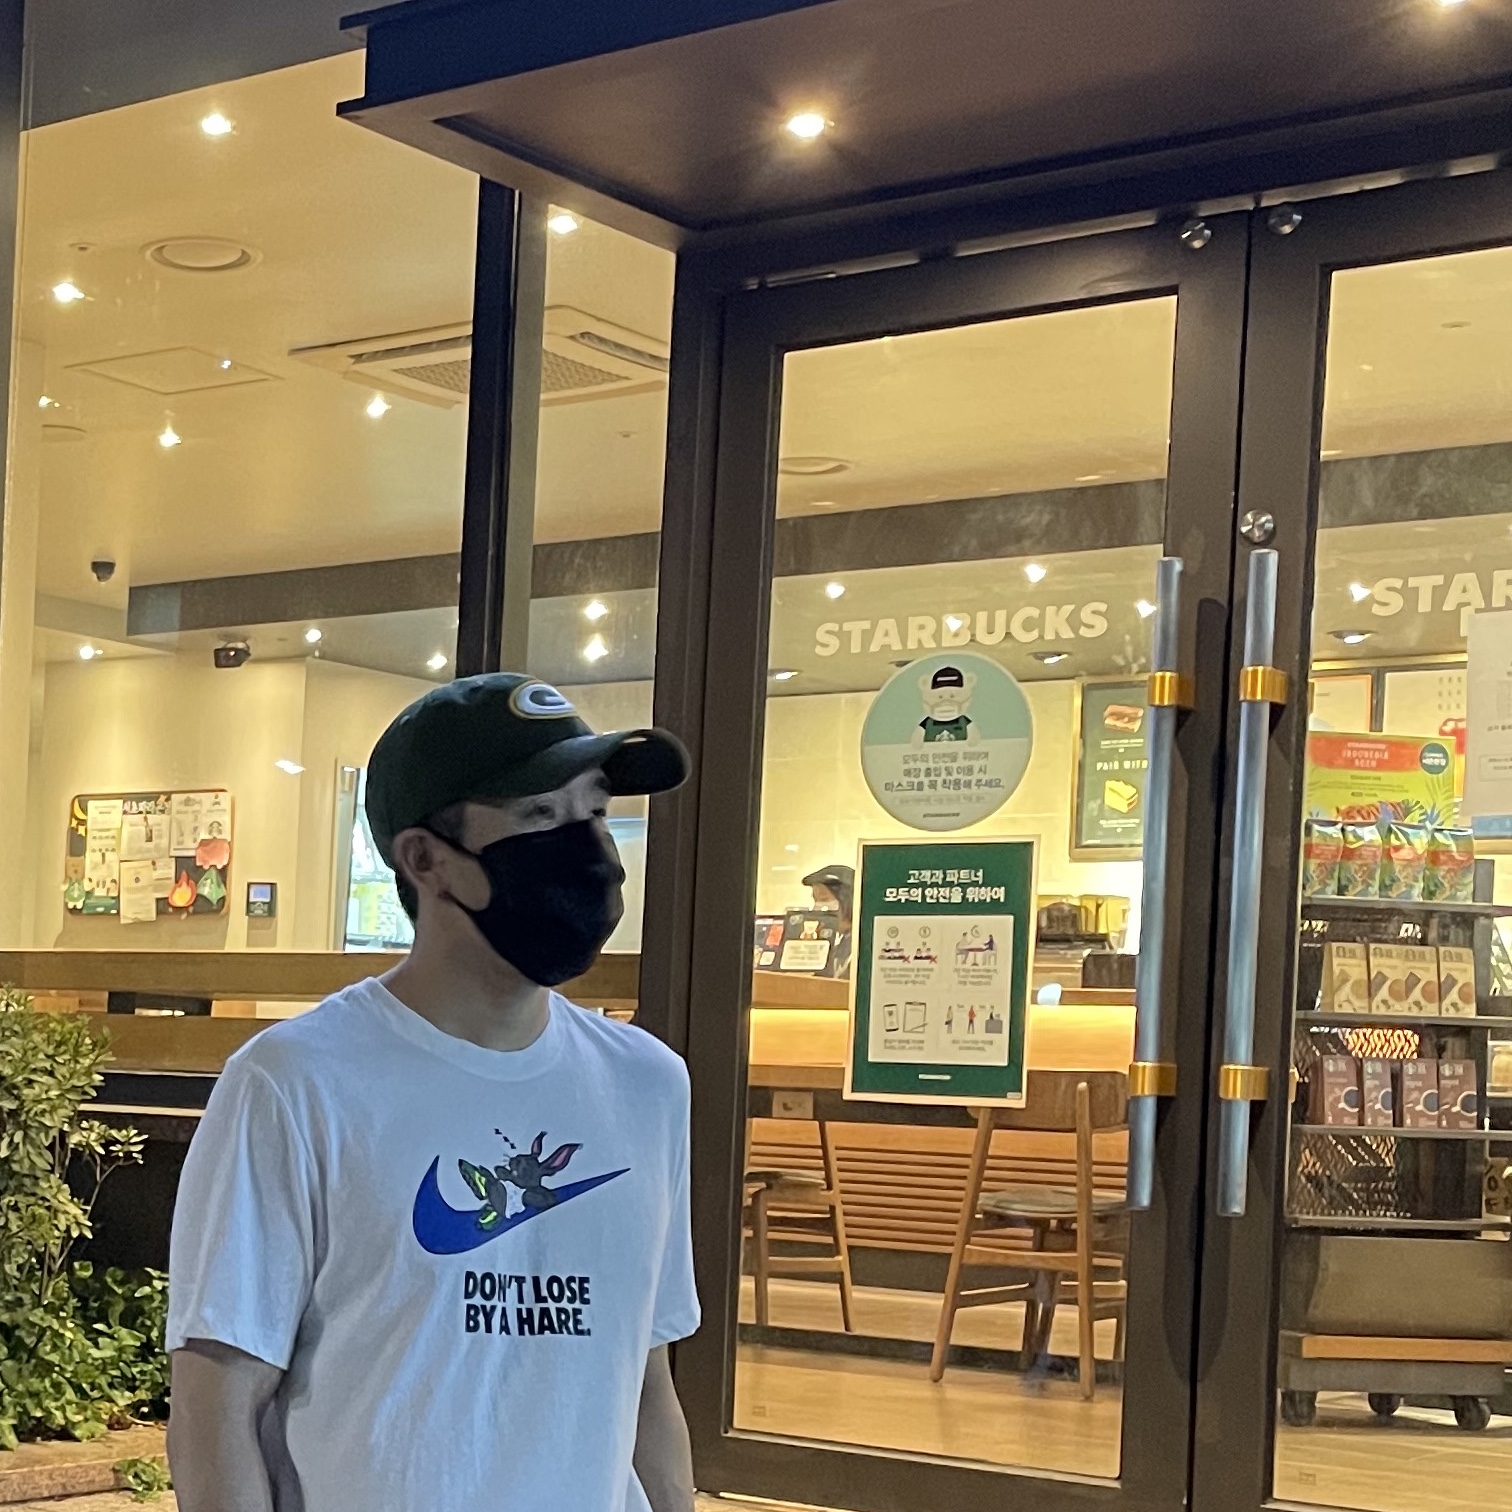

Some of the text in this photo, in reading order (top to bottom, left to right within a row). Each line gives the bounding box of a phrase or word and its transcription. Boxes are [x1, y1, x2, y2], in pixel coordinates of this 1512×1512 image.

[814, 601, 1109, 657] STARBUCKS
[977, 763, 988, 776] 시
[884, 780, 925, 792] 마스크를
[906, 868, 984, 885] 고객과 파트너
[884, 885, 1006, 903] 모두의 안전을 위하여
[464, 1270, 591, 1305] DON'T LOSE
[464, 1303, 591, 1336] BY A HARE.
